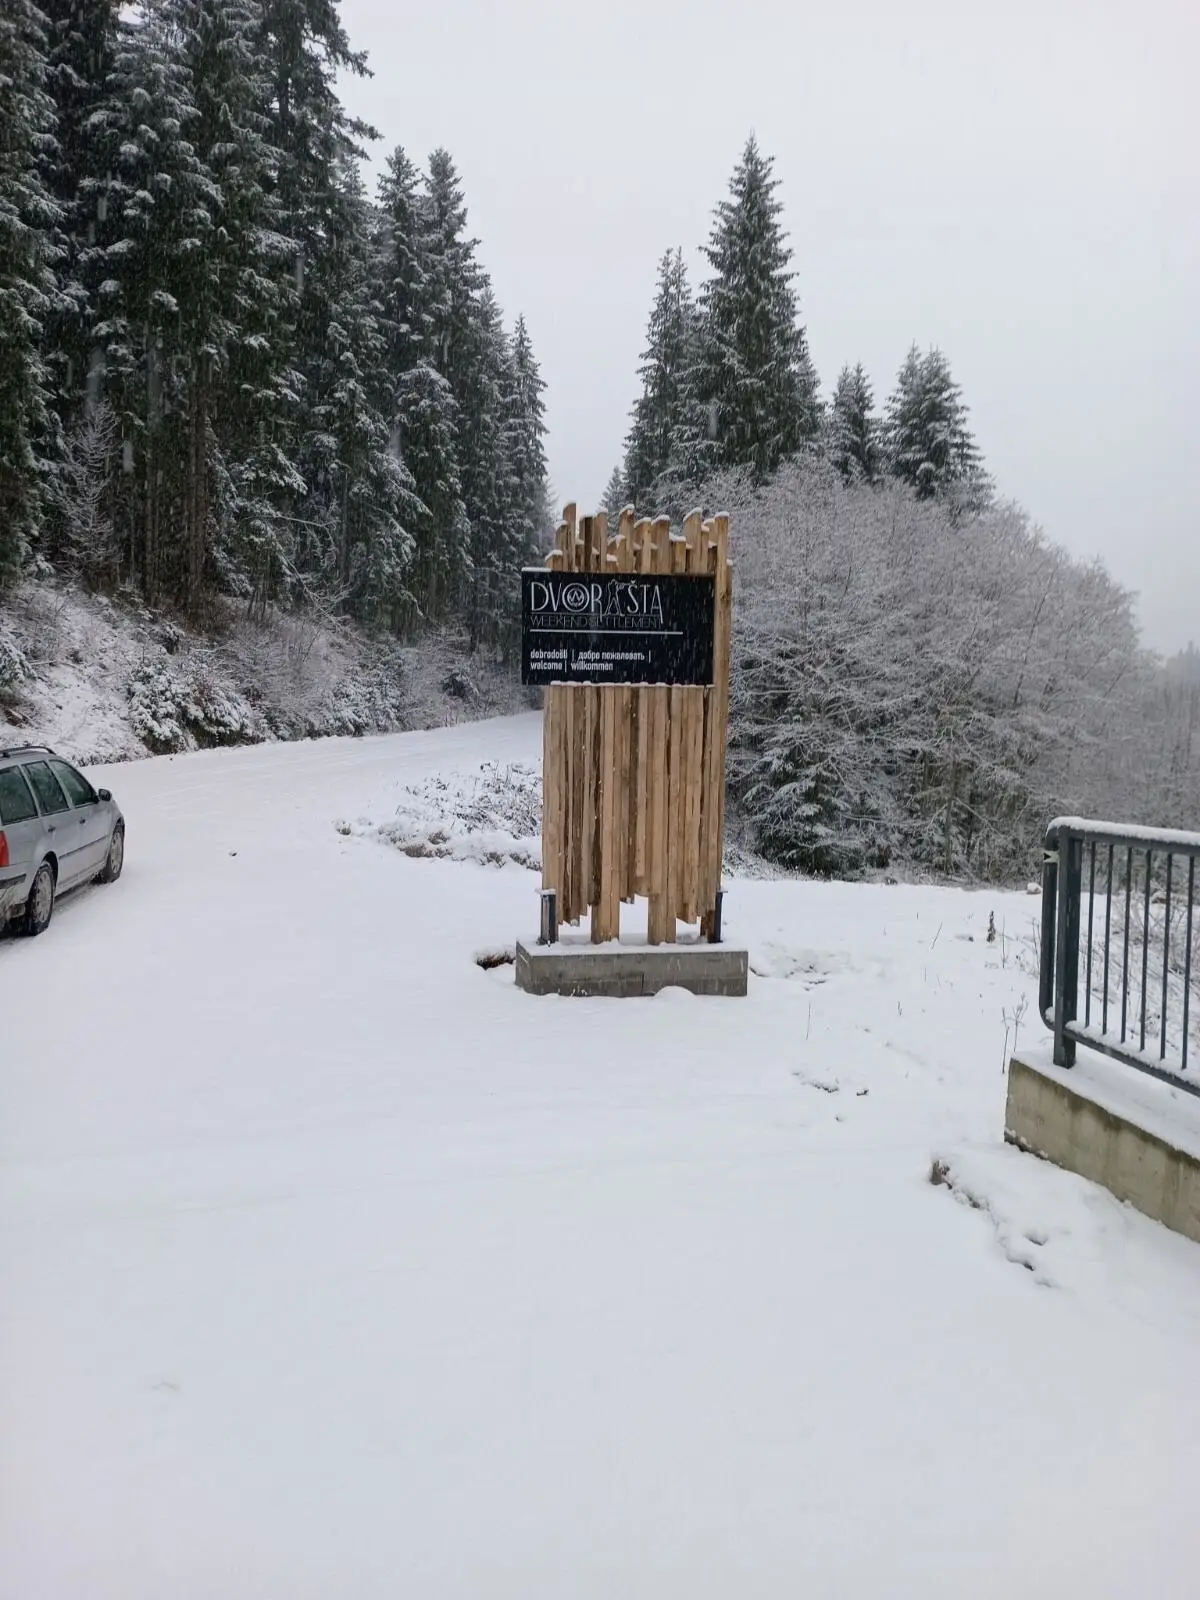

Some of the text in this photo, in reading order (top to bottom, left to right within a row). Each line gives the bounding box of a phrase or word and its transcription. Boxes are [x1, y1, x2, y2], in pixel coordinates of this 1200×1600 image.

[530, 615, 588, 627] WEEKEND
[578, 650, 645, 661] добро пожаловать
[530, 660, 613, 671] welcome willkommen
